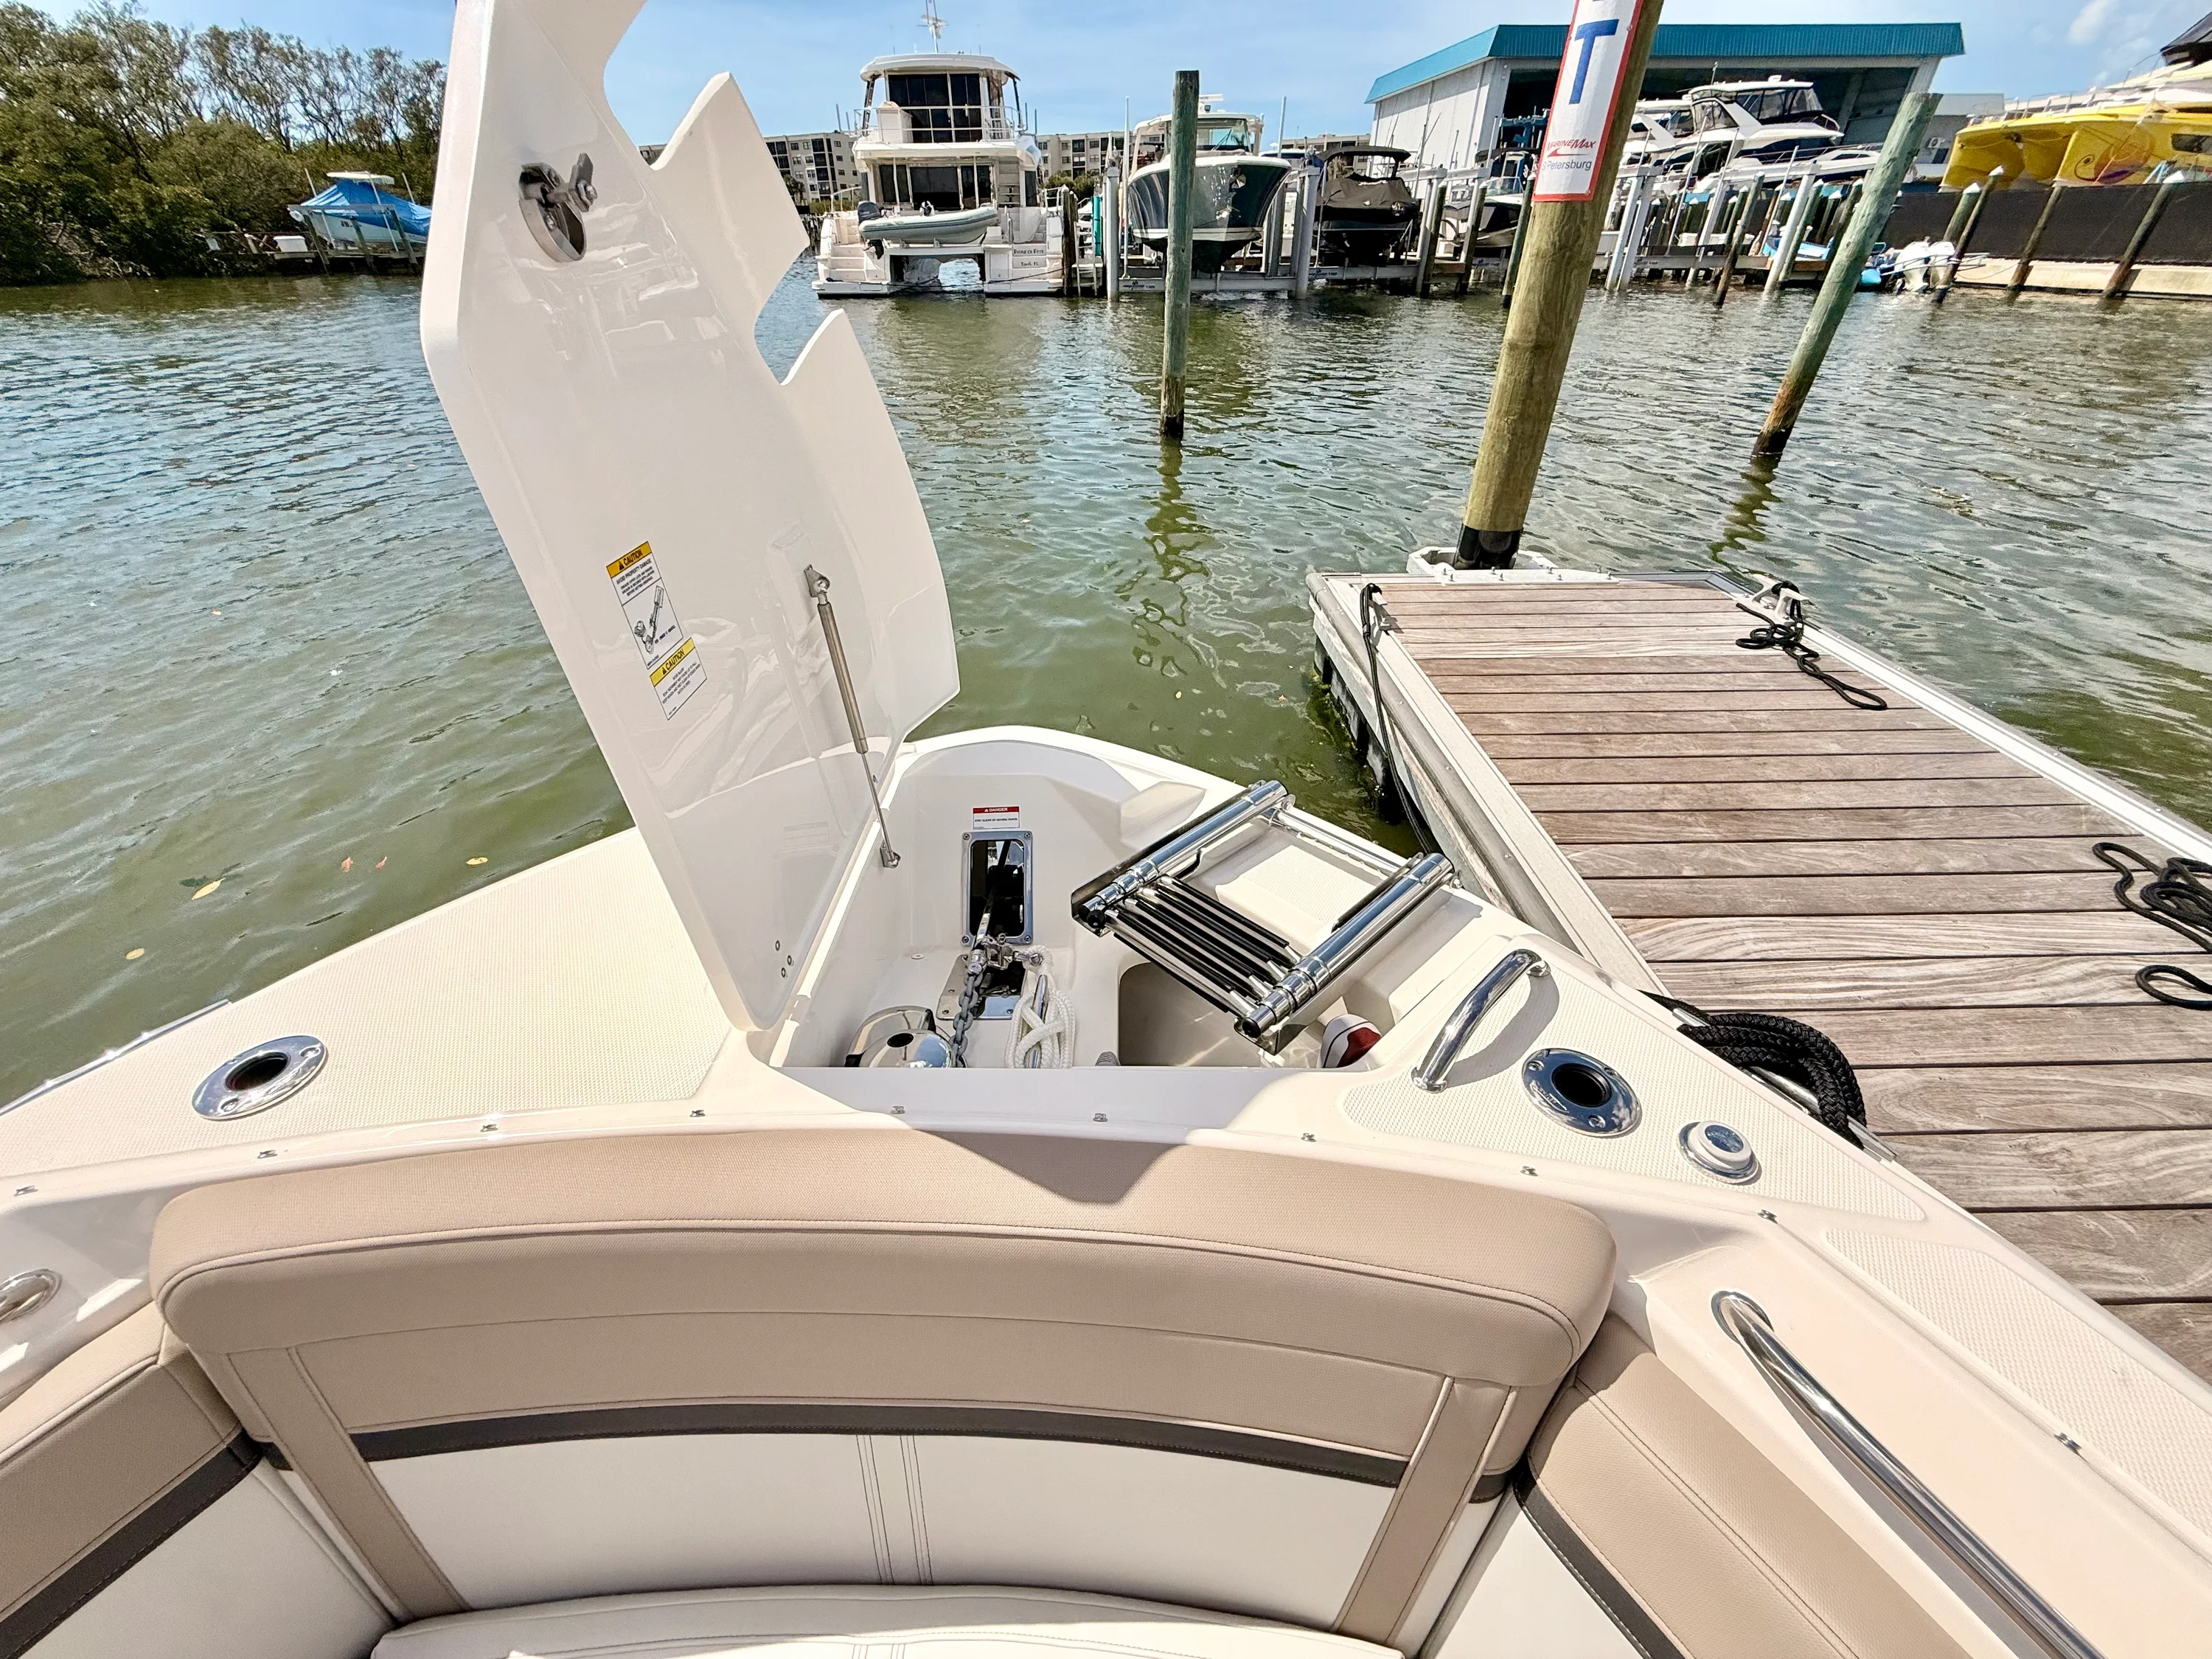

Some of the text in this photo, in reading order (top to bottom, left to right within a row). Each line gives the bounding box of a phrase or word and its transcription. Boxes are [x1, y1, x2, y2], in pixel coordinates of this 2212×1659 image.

[1568, 18, 1619, 105] T
[1547, 159, 1592, 171] Petersburg
[623, 549, 643, 566] CAUTION
[665, 649, 684, 670] CAUTION
